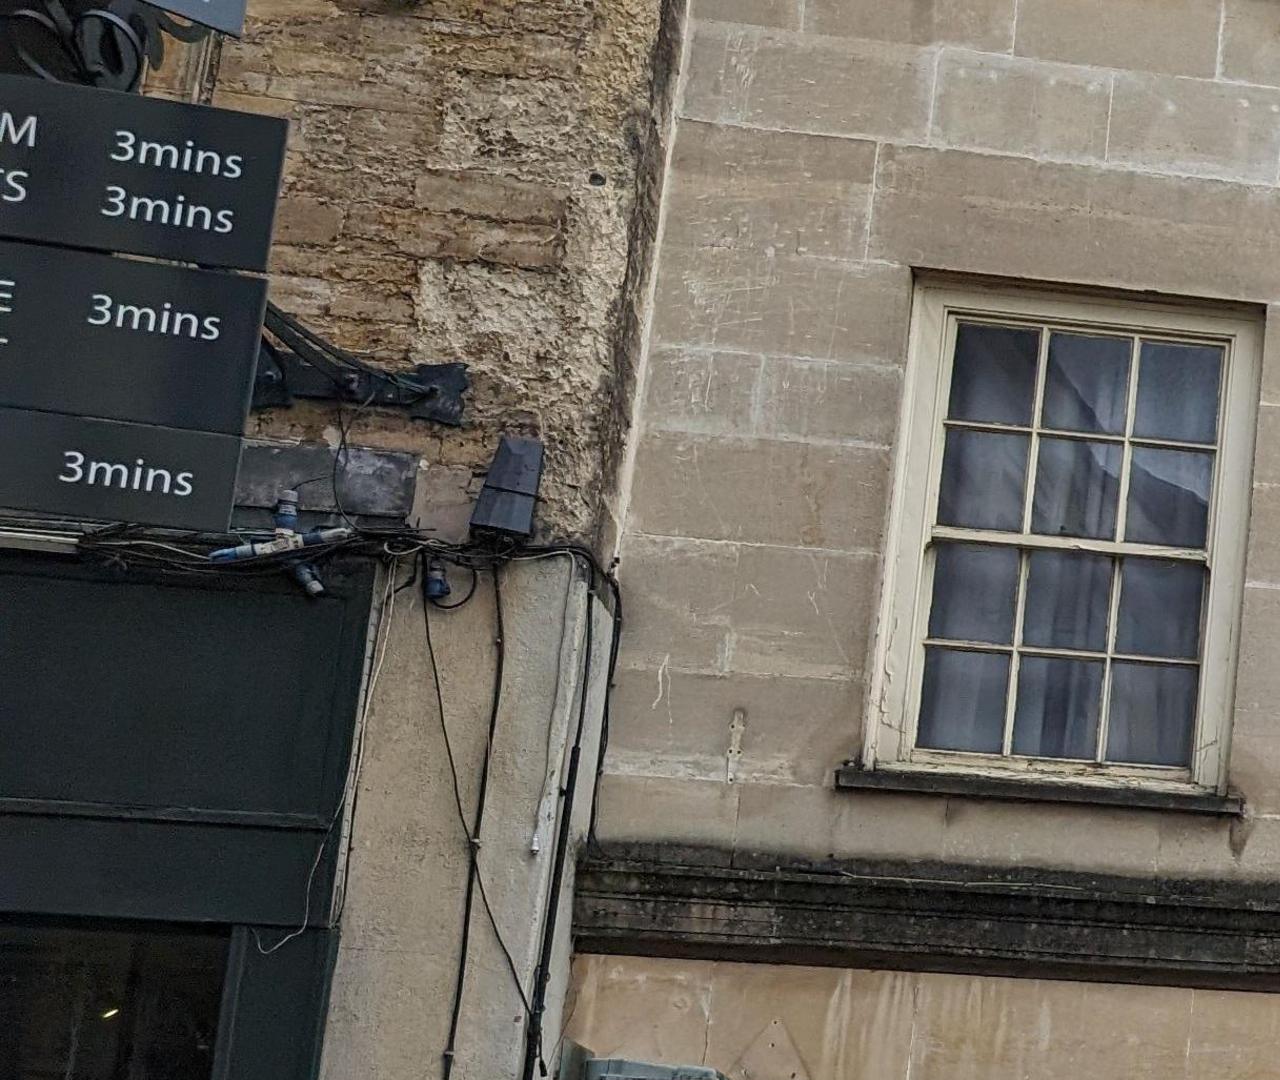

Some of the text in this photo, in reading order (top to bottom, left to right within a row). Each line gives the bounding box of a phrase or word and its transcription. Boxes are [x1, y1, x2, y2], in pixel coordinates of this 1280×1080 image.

[111, 130, 243, 178] 3mins
[0, 168, 234, 234] S 3mins
[87, 294, 221, 341] 3mins
[58, 450, 194, 497] 3mins
